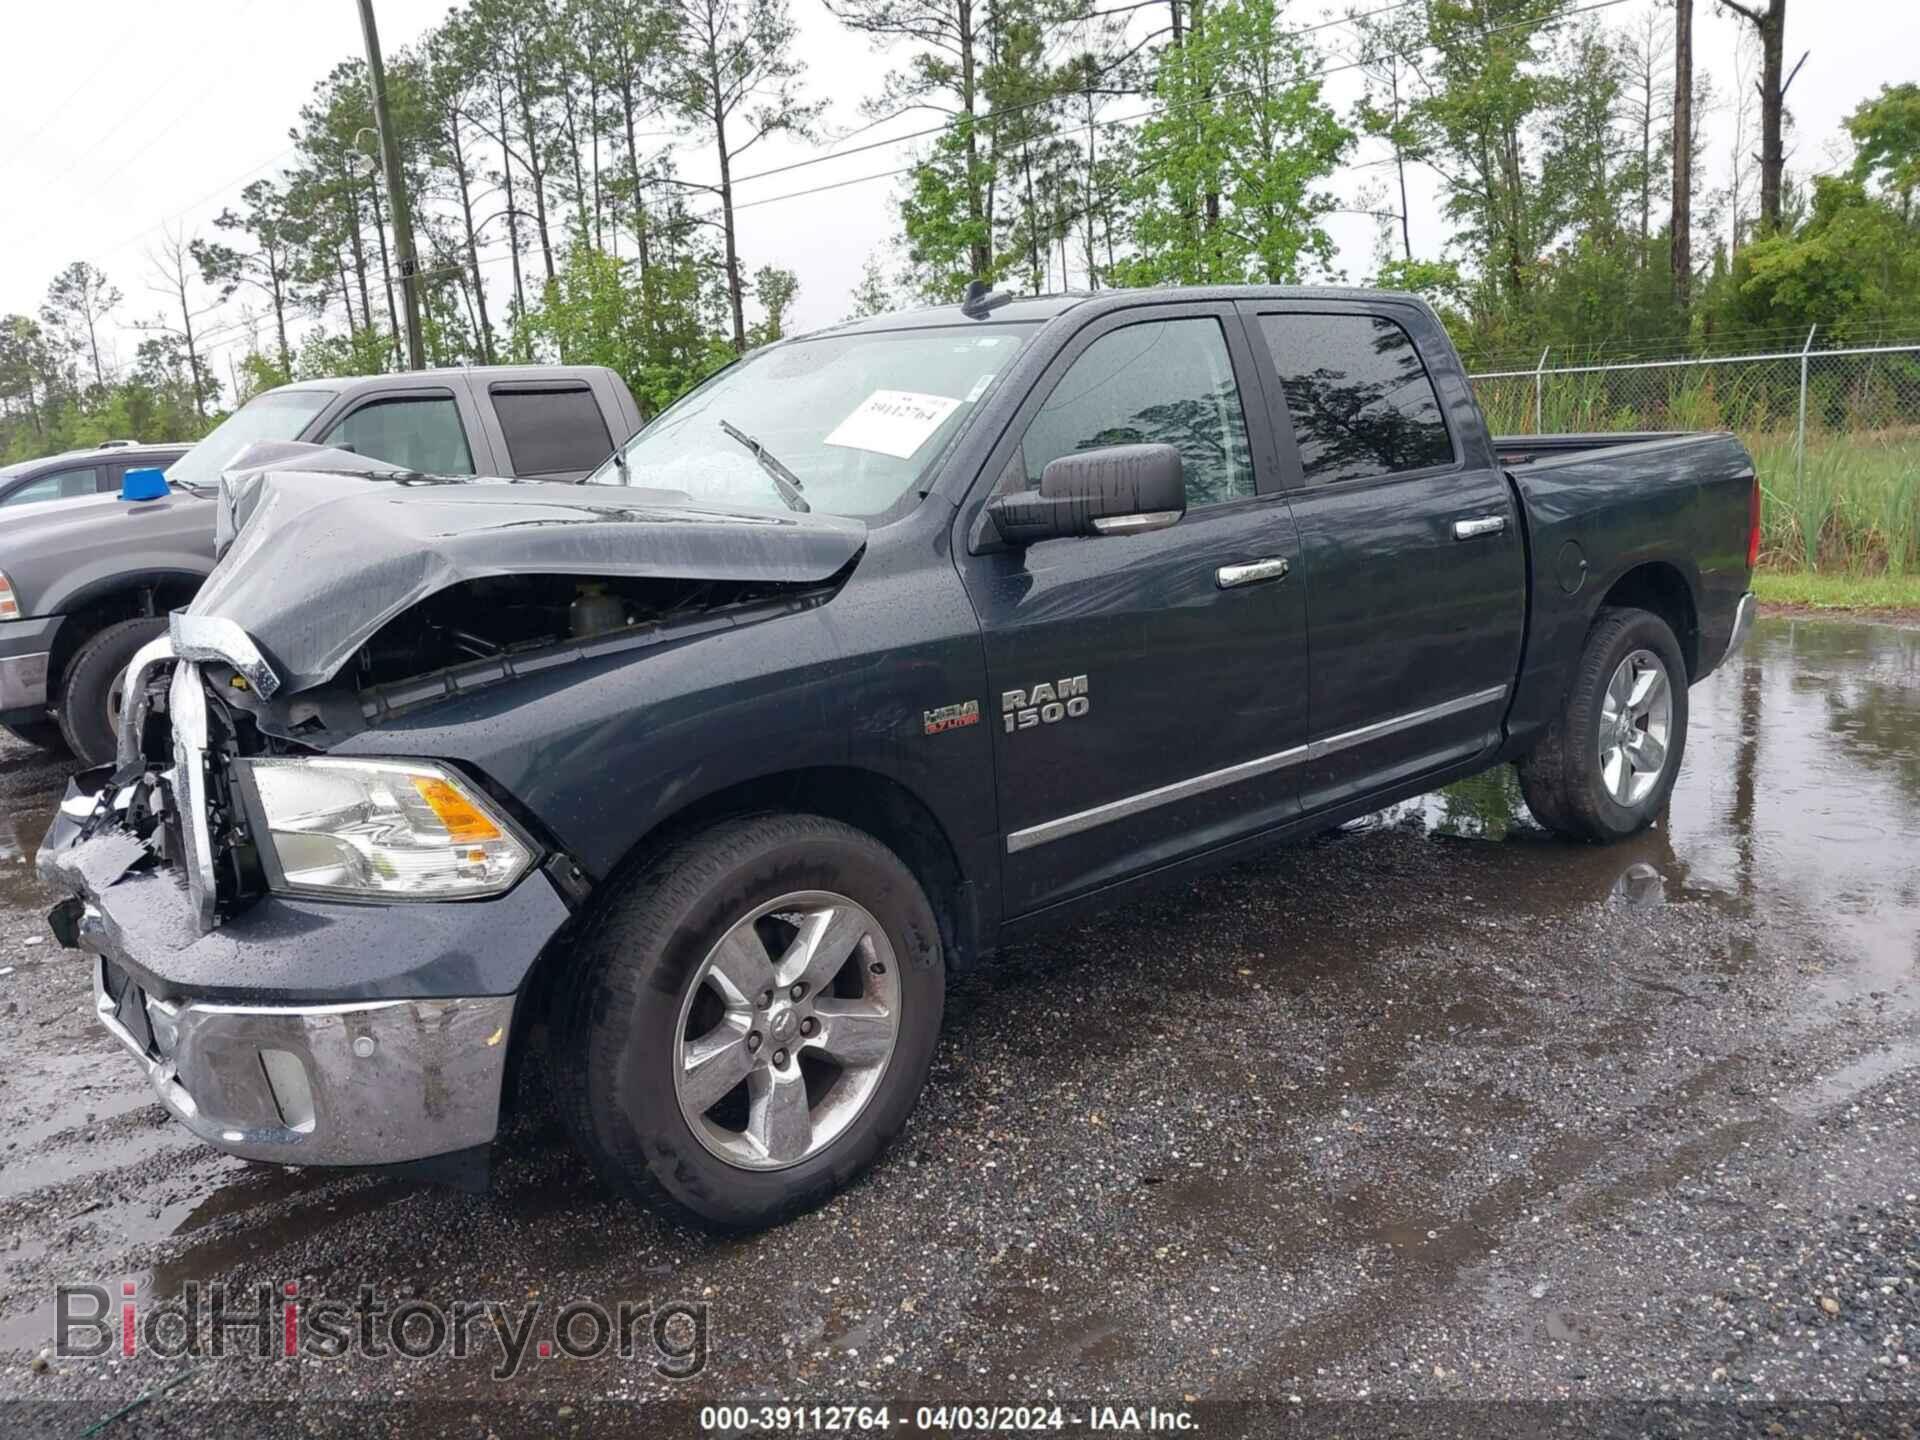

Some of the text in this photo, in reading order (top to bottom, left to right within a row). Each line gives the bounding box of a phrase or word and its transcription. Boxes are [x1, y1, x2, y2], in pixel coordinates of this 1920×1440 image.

[924, 700, 979, 724] HEMI
[1002, 675, 1089, 712] RAM
[1003, 696, 1090, 733] 1500
